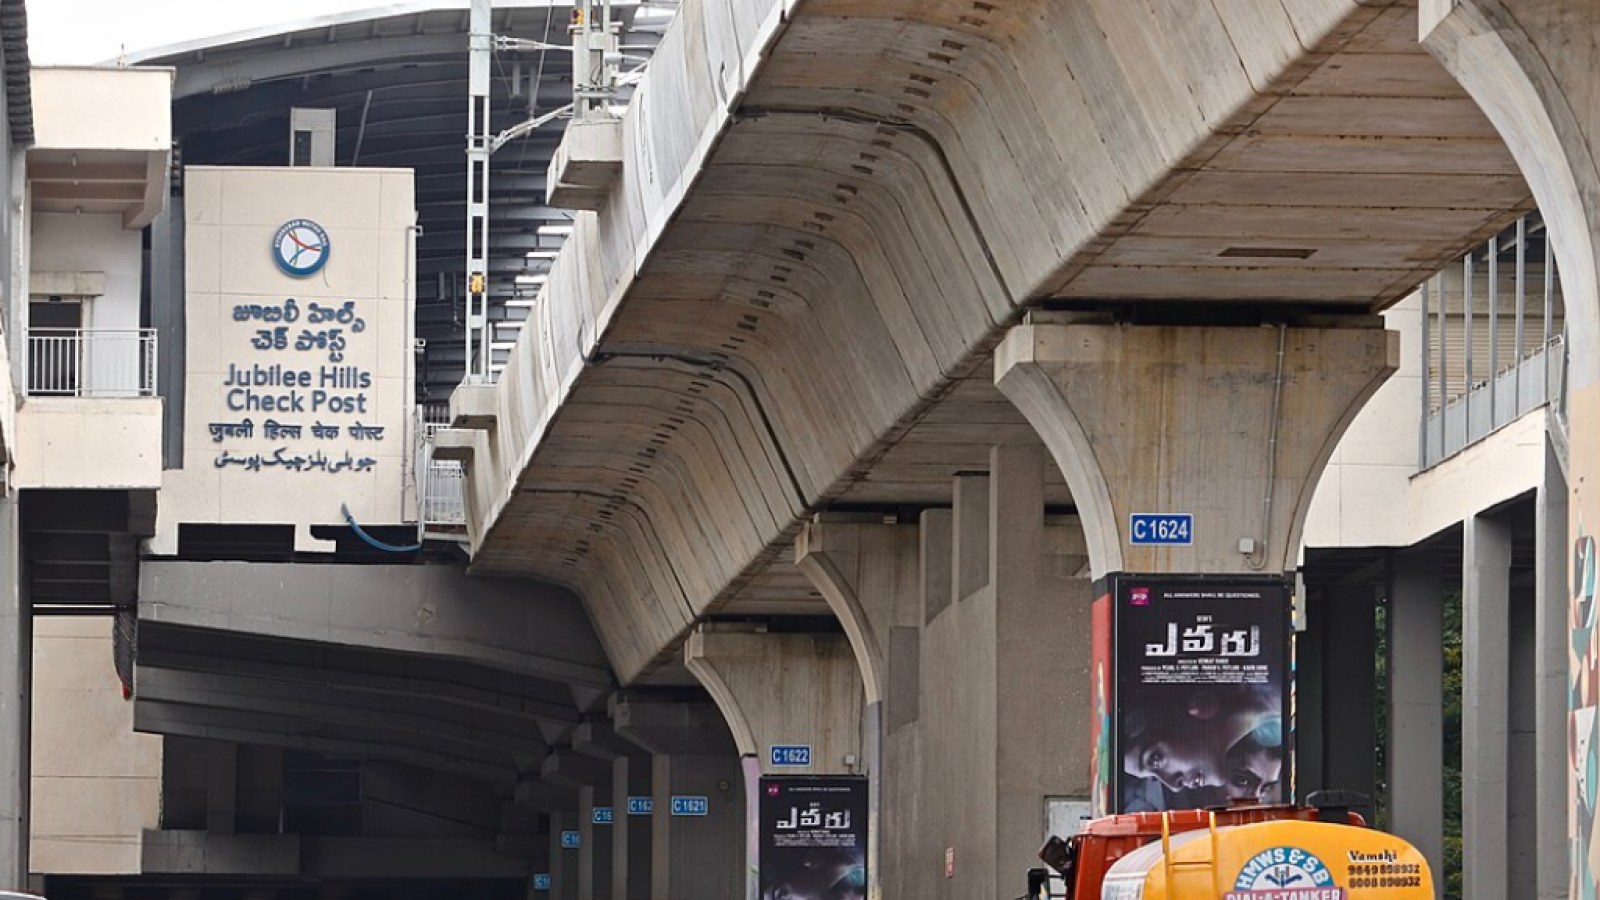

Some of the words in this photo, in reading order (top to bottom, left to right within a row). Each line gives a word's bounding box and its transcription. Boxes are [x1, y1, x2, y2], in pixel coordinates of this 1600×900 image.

[250, 326, 289, 350] చెక్
[294, 329, 346, 363] పోస్ట్
[224, 363, 312, 387] Jubilee
[319, 366, 372, 389] Hills
[227, 388, 305, 412] Check
[312, 390, 367, 413] Post
[208, 418, 254, 443] जुबली
[263, 418, 302, 440] हिल्स
[311, 420, 339, 440] चेक
[348, 421, 385, 440] पोस्ट
[1150, 520, 1188, 539] 1624
[1236, 848, 1286, 888] HMWS
[1289, 849, 1305, 864] &
[1348, 850, 1398, 863] Vamshi
